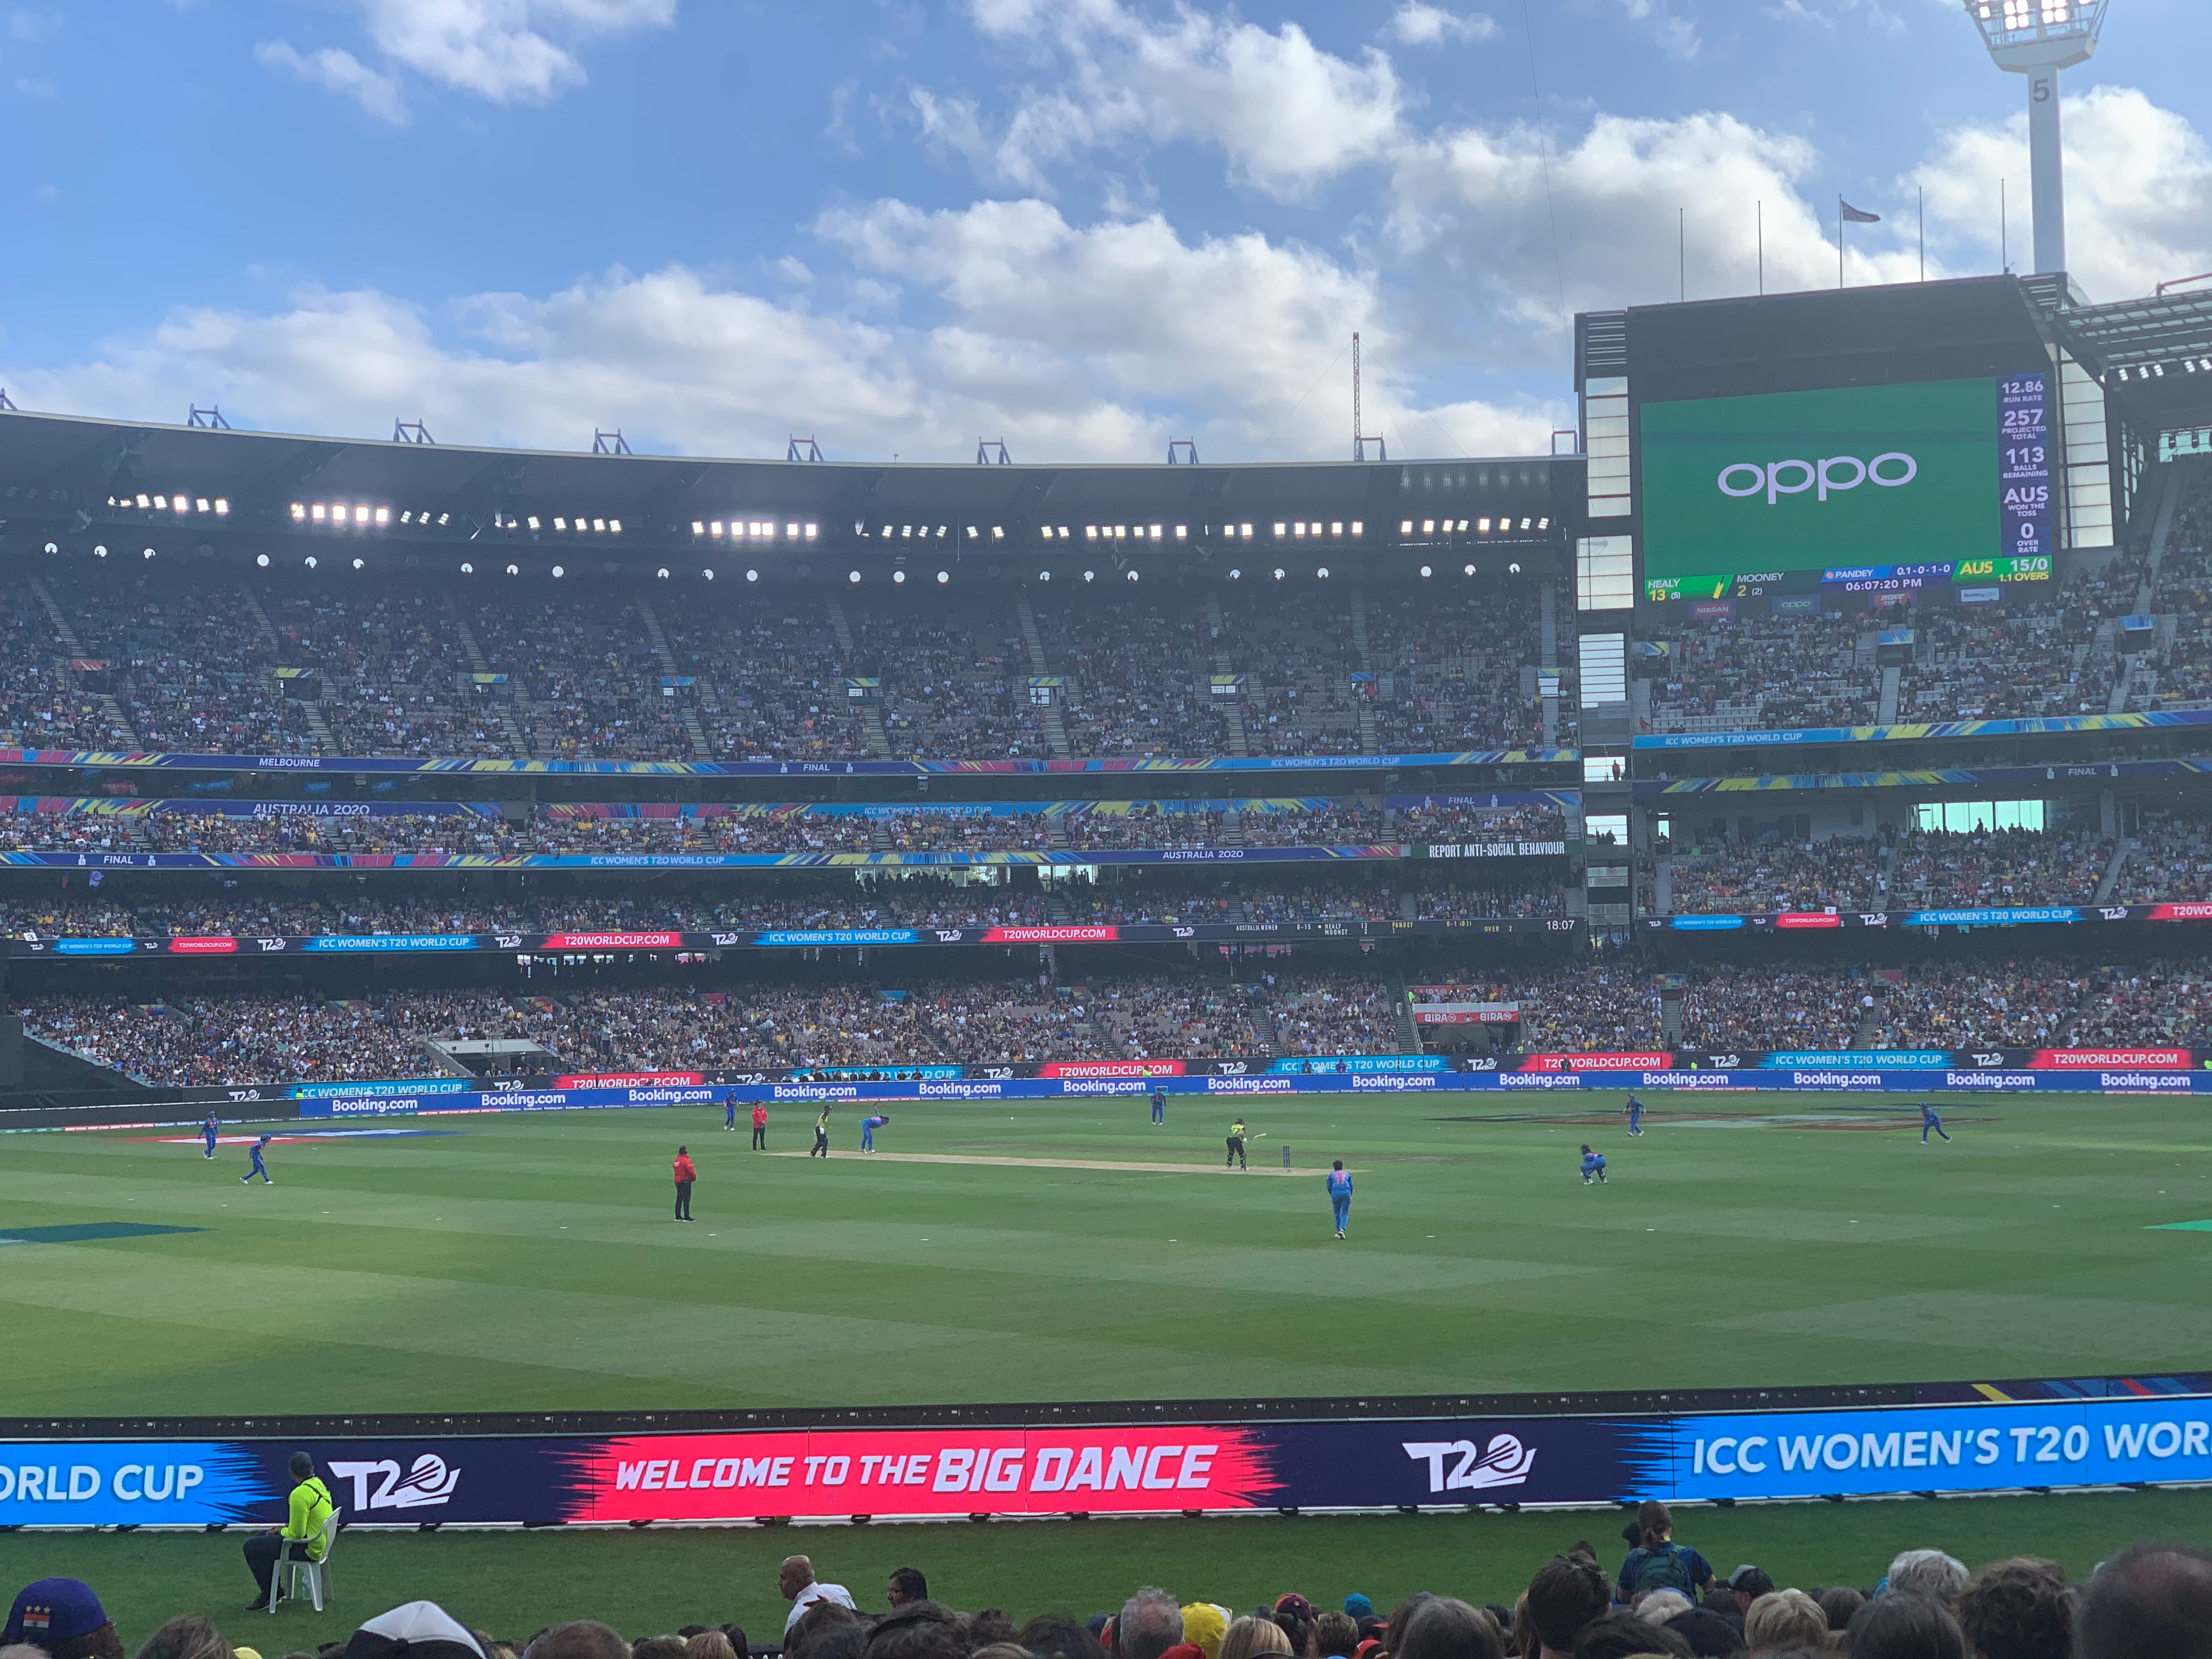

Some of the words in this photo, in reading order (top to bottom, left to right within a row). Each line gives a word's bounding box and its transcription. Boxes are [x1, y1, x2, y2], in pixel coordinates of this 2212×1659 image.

[2033, 78, 2050, 102] 5
[2002, 381, 2044, 394] 12.86
[2004, 409, 2043, 426] 257
[2002, 426, 2046, 434] PROJECTED
[2006, 447, 2044, 464] 113
[1718, 452, 1917, 505] oppo
[2003, 470, 2048, 478] REMAINING
[2004, 486, 2049, 504] AUS
[2021, 523, 2034, 539] 0
[1960, 561, 1993, 575] AUS
[2010, 558, 2047, 572] 15/0
[1835, 569, 1873, 578] PANDEY
[1999, 574, 2012, 582] 1.1
[2015, 572, 2049, 582] OVERS
[1648, 579, 1680, 589] HEALY
[1736, 572, 1784, 583] MOONEY
[1846, 579, 1898, 591] 06:07:20
[1903, 578, 1922, 588] PM
[1649, 589, 1666, 601] 13
[1671, 591, 1681, 600] (5)
[1737, 585, 1747, 597] 2
[1752, 587, 1763, 596] (2)
[1681, 736, 1724, 745] WOMEN'S
[1746, 734, 1781, 742] WORLD
[1783, 733, 1802, 741] CUP
[259, 758, 320, 768] MELBOURNE
[803, 764, 830, 772] FINAL
[2068, 768, 2097, 776] FINAL
[252, 804, 329, 815] AUSTRALIA
[334, 804, 370, 815] 2020
[974, 806, 992, 814] CUP
[1163, 850, 1214, 860] AUSTRALIA
[1218, 850, 1244, 859] 2020
[1429, 844, 1461, 858] REPORT
[1464, 843, 1516, 857] ANTI-SOCIAL
[1519, 842, 1565, 855] BEHAVIOUR
[103, 855, 133, 865] FINAL
[591, 856, 603, 865] ICC
[605, 856, 649, 865] WOMEN'S
[651, 856, 669, 865] T20
[669, 856, 703, 865] WORLD
[706, 856, 725, 865] CUP
[1920, 913, 1936, 922] ICC
[1938, 911, 1989, 921] WOMEN'S
[1990, 911, 2008, 919] T20
[2012, 911, 2049, 920] WORLD
[2052, 910, 2072, 919] CUP
[1546, 920, 1575, 930] 18:07
[564, 935, 669, 945] T20WORLDCUP.COM
[769, 933, 785, 942] ICC
[787, 933, 833, 941] WOMEN'S
[834, 933, 852, 941] T20
[854, 932, 889, 941] WORLD
[891, 932, 910, 940] CUP
[1003, 929, 1106, 940] T20WORLDCUP.COM
[319, 939, 335, 947] ICC
[338, 939, 386, 948] WOMEN'S
[389, 939, 408, 947] T20
[410, 938, 447, 947] WORLD
[449, 938, 469, 946] CUP
[1355, 1061, 1373, 1069] T20
[1376, 1060, 1414, 1069] WORLD
[1417, 1059, 1439, 1068] CUP
[1775, 1056, 1793, 1065] ICC
[1796, 1055, 1850, 1065] WOMEN'S
[1852, 1055, 1872, 1064] T20
[1876, 1055, 1918, 1064] WORLD
[1920, 1054, 1943, 1064] CUP
[2054, 1053, 2177, 1065] T20WORLDCUP.COM
[934, 1070, 955, 1079] CUP
[1499, 1073, 1580, 1086] Booking.com
[1643, 1073, 1728, 1087] Booking.com
[1794, 1073, 1881, 1086] Booking.com
[1946, 1073, 2035, 1087] Booking.com
[1064, 1079, 1146, 1093] Booking.com
[1207, 1077, 1290, 1091] Booking.com
[1352, 1076, 1435, 1088] Booking.com
[2101, 1073, 2191, 1089] Booking.com
[375, 1086, 394, 1094] T20
[398, 1085, 437, 1094] WORLD
[441, 1084, 462, 1092] CUP
[774, 1086, 857, 1098] Booking.com
[919, 1081, 1001, 1096] Booking.com
[481, 1092, 566, 1107] Booking.com
[629, 1088, 712, 1103] Booking.com
[332, 1098, 418, 1112] Booking.com
[1693, 1437, 1768, 1474] ICC
[1777, 1427, 2000, 1471] WOMEN'S
[2010, 1426, 2089, 1463] T20
[2104, 1421, 2212, 1459] WOR
[616, 1457, 793, 1491] WELCOME
[805, 1455, 850, 1485] TO
[858, 1453, 933, 1485] THE
[931, 1447, 1027, 1492] BIG
[1029, 1445, 1218, 1491] DANCE
[0, 1465, 101, 1501] ORLD
[112, 1464, 204, 1500] CUP
